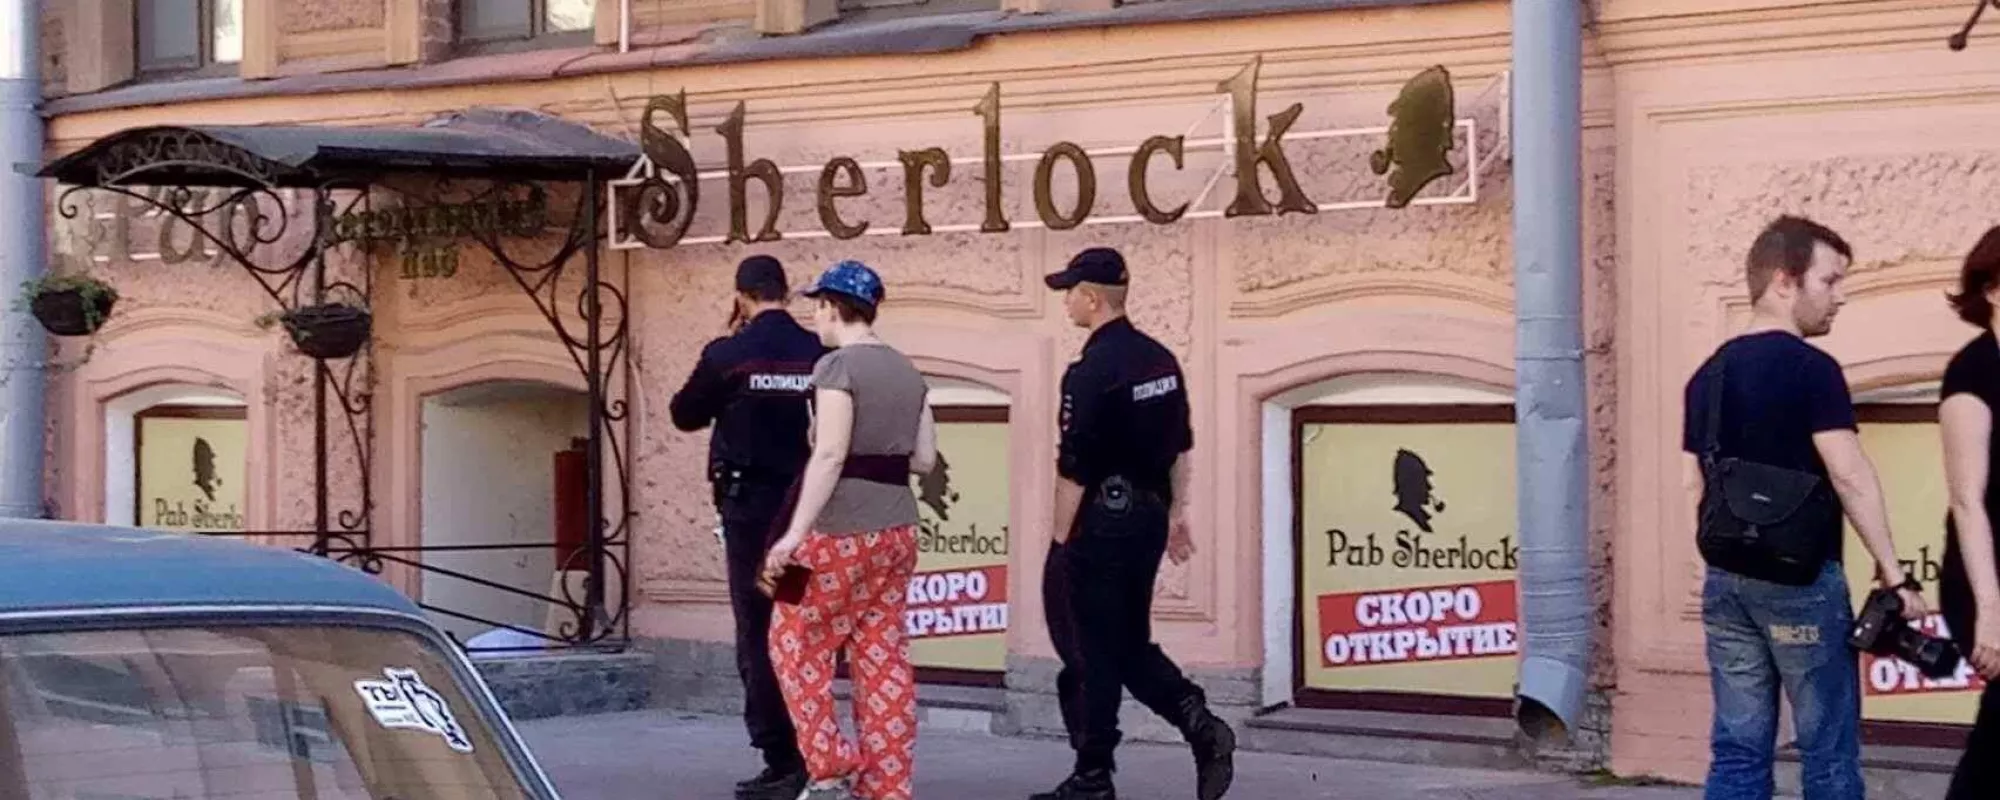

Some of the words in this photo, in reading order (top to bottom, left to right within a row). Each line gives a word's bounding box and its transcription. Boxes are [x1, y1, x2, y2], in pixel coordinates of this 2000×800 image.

[624, 55, 1318, 249] Sherlock
[1392, 530, 1519, 570] Sherlock
[1355, 587, 1481, 626] СКОРО
[1325, 622, 1518, 664] ОТКРЫТИЕ
